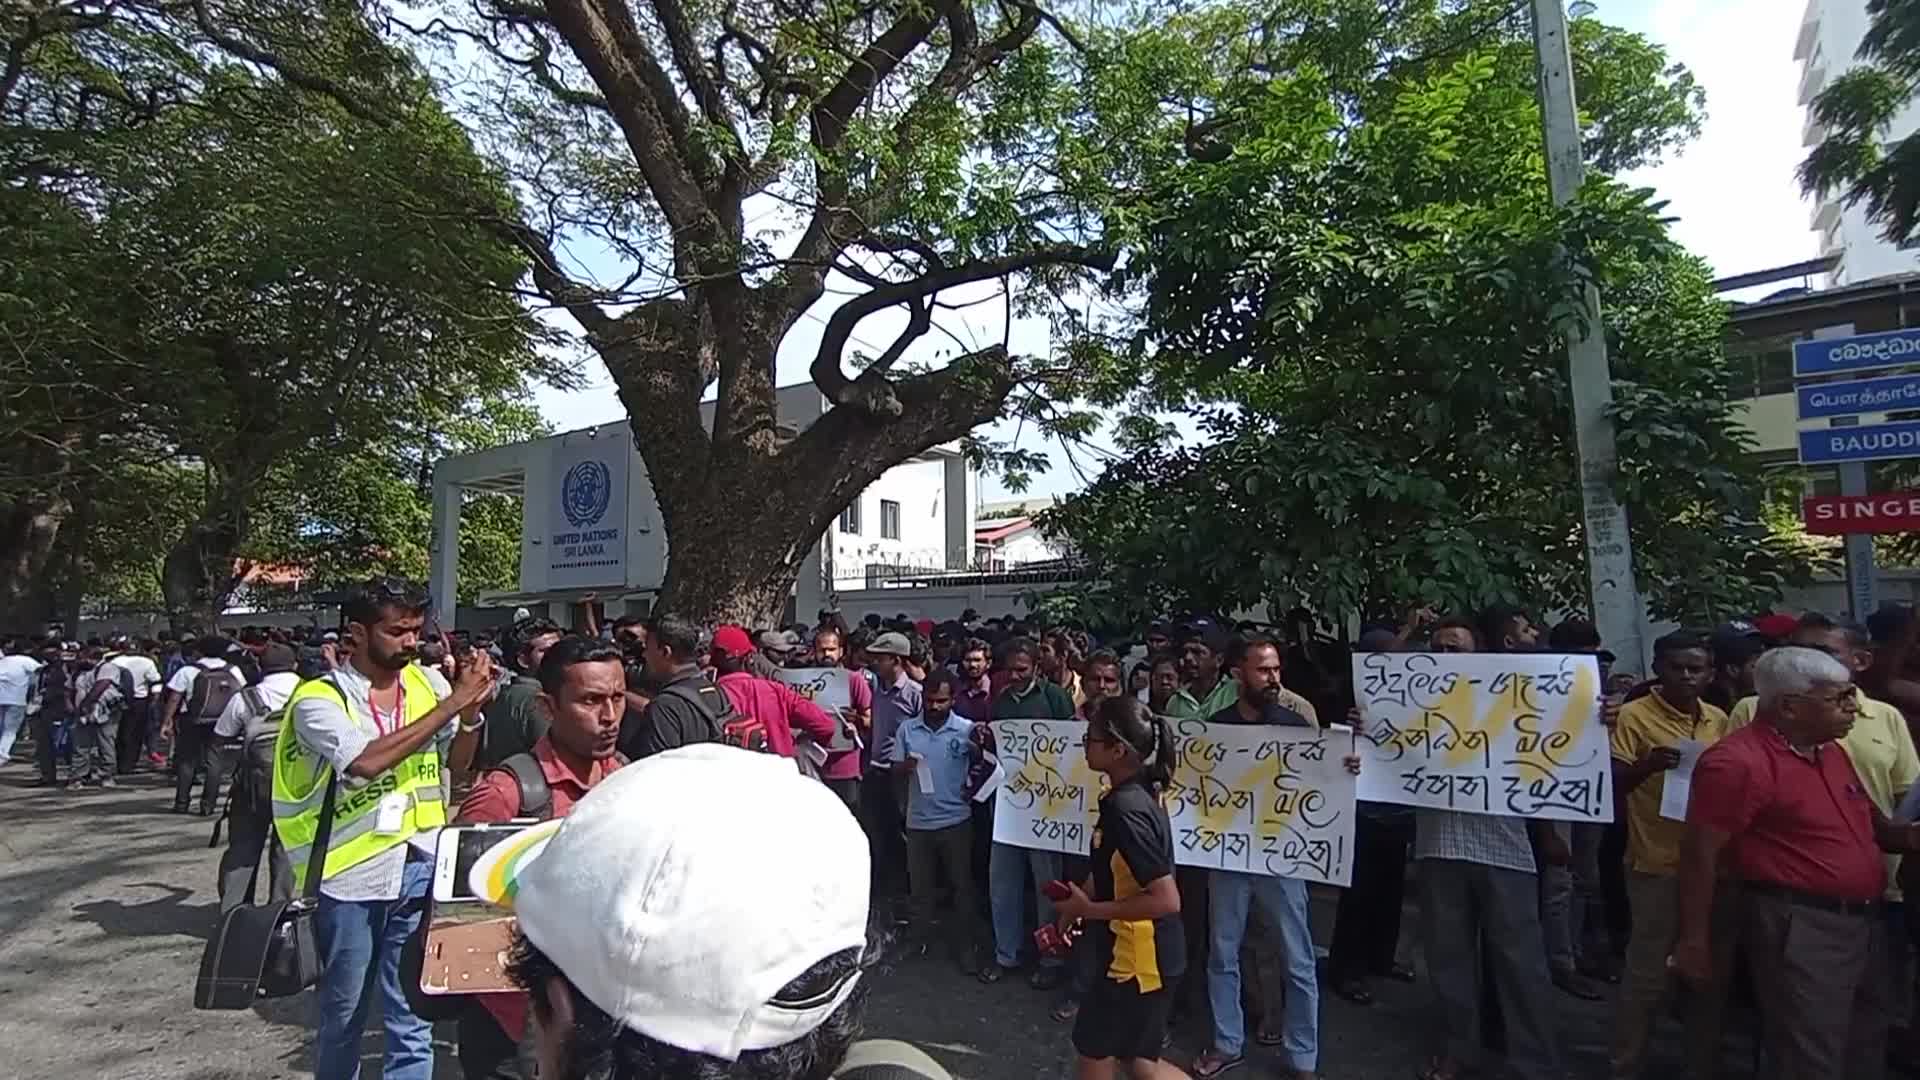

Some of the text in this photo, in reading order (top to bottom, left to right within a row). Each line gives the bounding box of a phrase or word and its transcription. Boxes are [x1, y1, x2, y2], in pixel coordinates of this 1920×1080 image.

[553, 528, 618, 545] UNITED NATIONS
[564, 543, 605, 557] SRI LANKA
[1513, 714, 1598, 768] මිල
[332, 774, 398, 820] RESS
[1273, 774, 1342, 828] මිල
